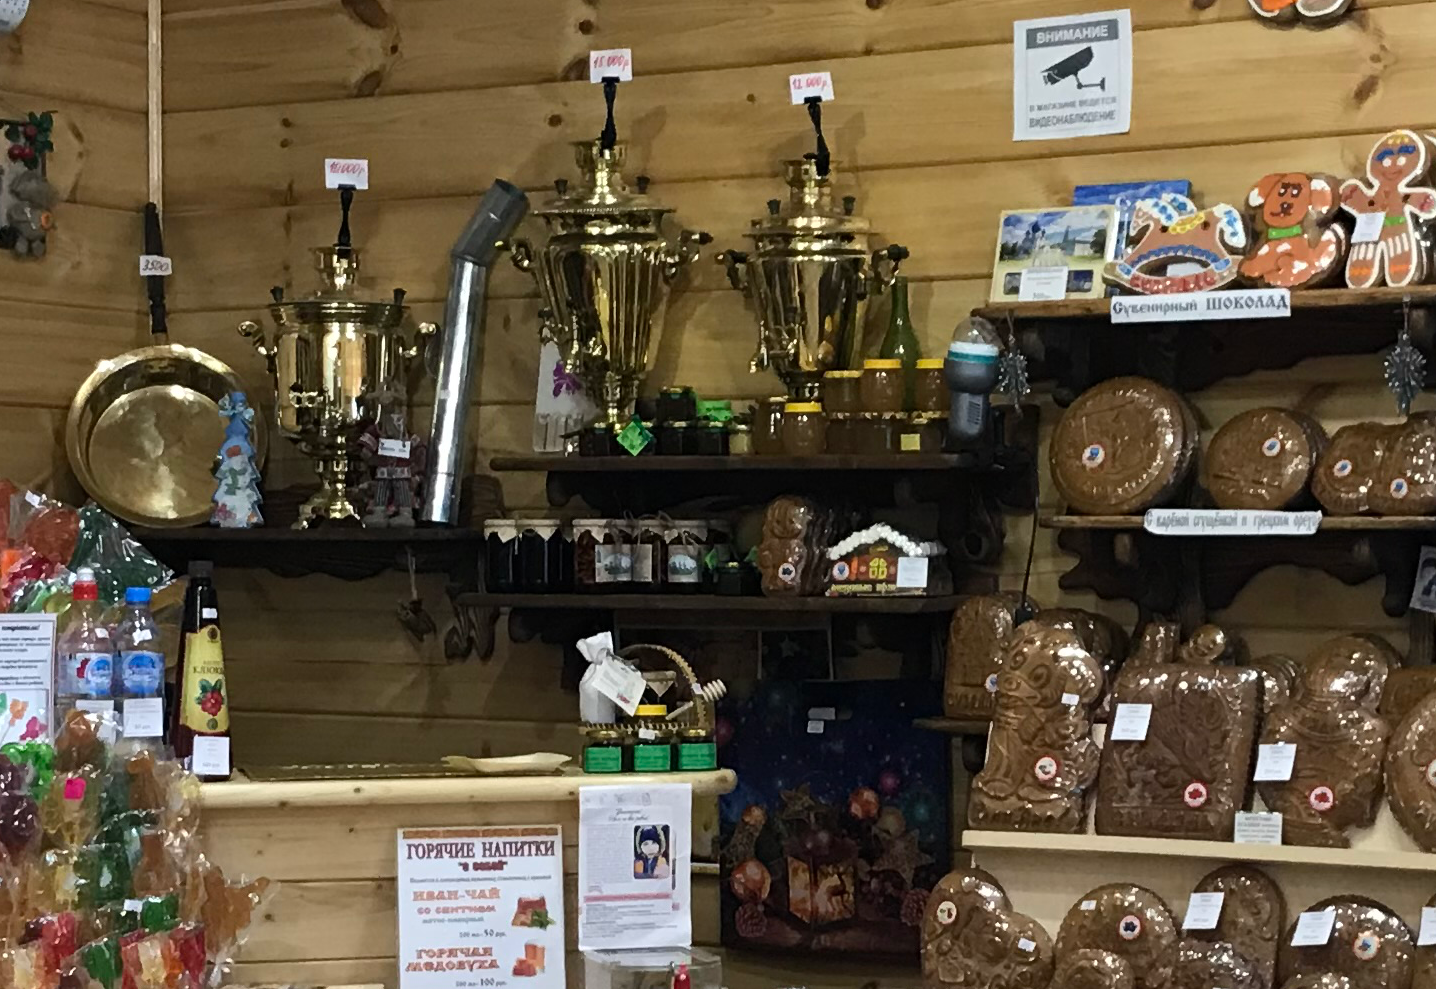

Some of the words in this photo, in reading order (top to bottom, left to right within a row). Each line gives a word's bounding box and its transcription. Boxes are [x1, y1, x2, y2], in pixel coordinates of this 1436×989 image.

[1036, 25, 1109, 44] ВНИМАНИЕ
[1036, 101, 1076, 112] МАГАЗИНЕ
[1029, 110, 1116, 129] ВИДЕОНАБЛЮДЕНИЕ
[1112, 299, 1198, 317] Сувенирный
[1206, 294, 1289, 311] ШОКОЛАД
[406, 842, 475, 860] ГОРЯЧИЕ
[482, 840, 555, 858] НАПИТКИ
[413, 887, 501, 901] ИВАН-ЧАЙ
[484, 929, 495, 938] 50
[416, 947, 493, 959] ГОРЯЧАЯ
[405, 959, 500, 973] МЕДОВУХА
[480, 978, 494, 987] 100
